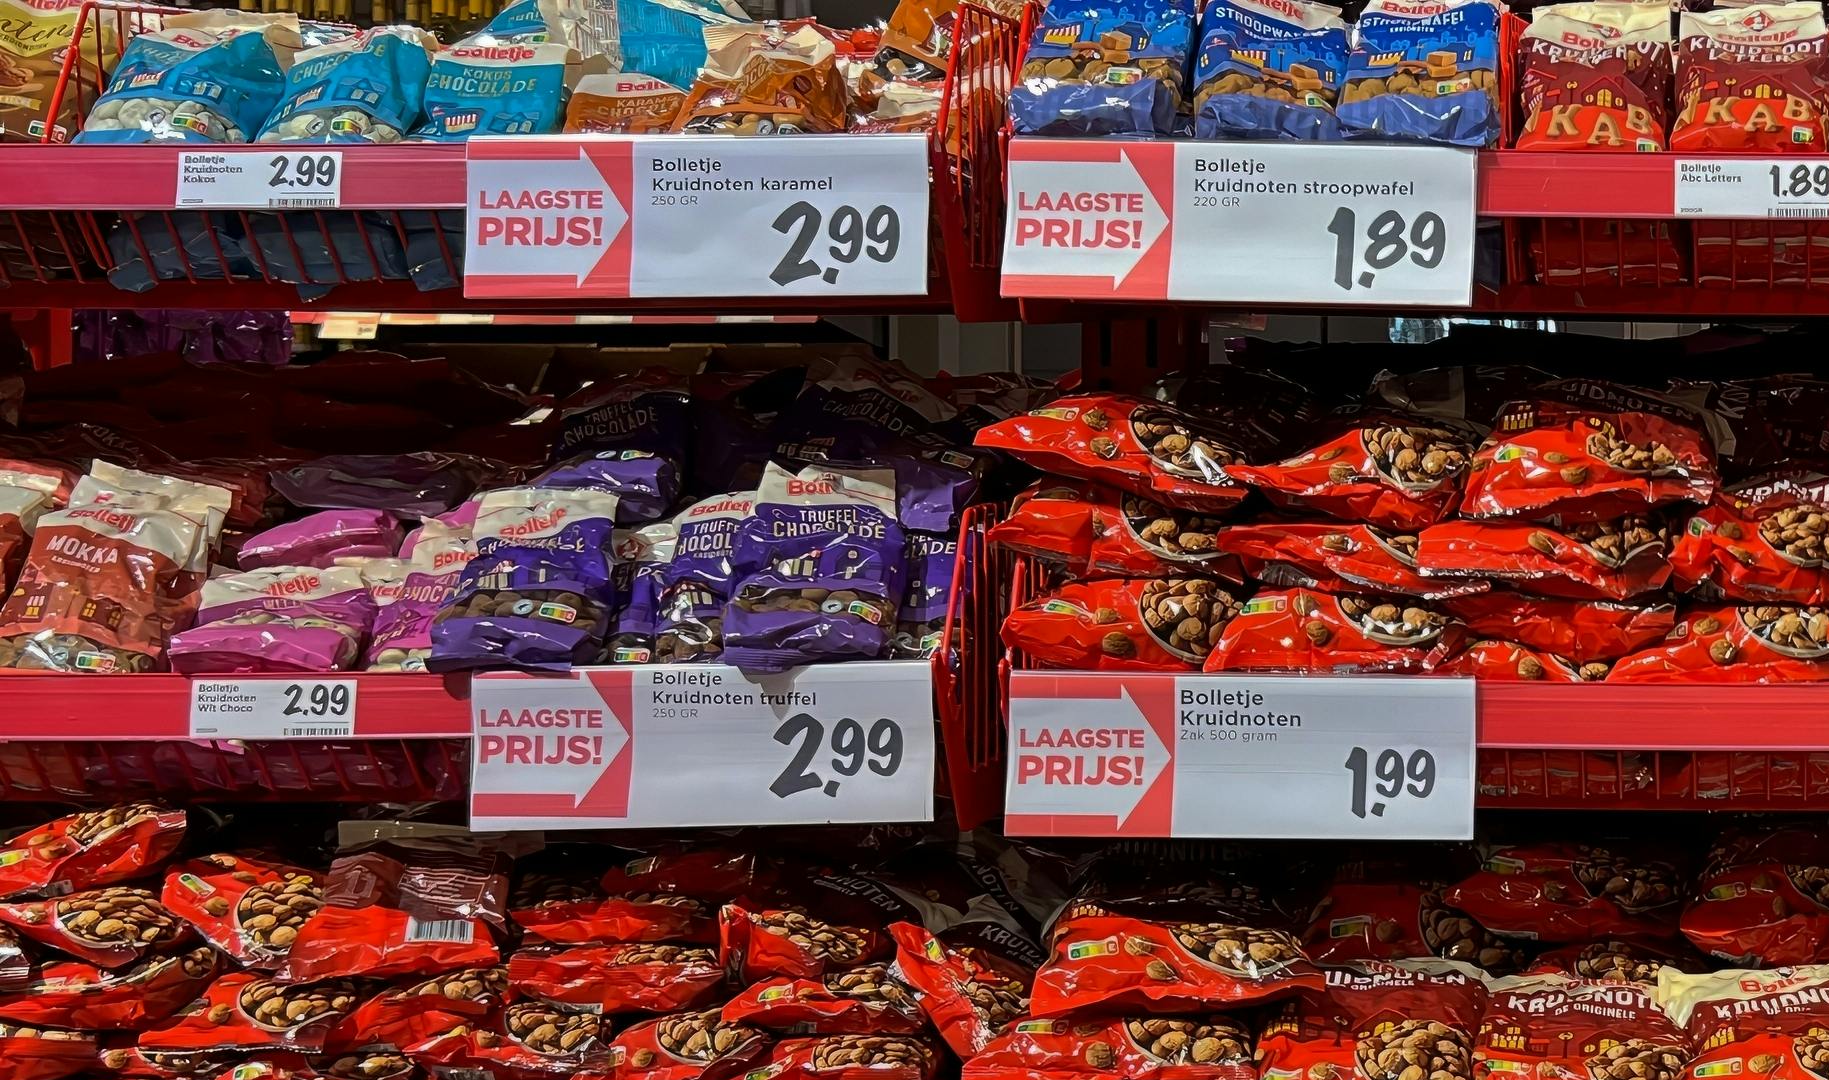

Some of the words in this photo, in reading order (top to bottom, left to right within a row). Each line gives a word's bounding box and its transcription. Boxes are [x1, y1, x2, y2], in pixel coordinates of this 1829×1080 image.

[463, 67, 512, 79] KOKOS
[184, 155, 226, 164] Bolletje
[652, 158, 722, 174] Bolletje
[1194, 158, 1266, 175] Bolletje
[184, 165, 243, 174] Kruidnoten
[268, 155, 336, 187] 2.99
[1680, 164, 1721, 174] Bolletje
[652, 176, 754, 192] Kruidnoten
[760, 176, 833, 192] karamel
[1680, 174, 1701, 183] Abc
[1705, 174, 1742, 183] Letters
[1194, 178, 1297, 195] Kruidnoten
[1303, 181, 1415, 198] stroopwafel
[478, 190, 604, 210] LAAGSTE
[652, 195, 677, 206] 250
[680, 195, 698, 206] GR
[1018, 191, 1144, 213] LAAGSTE
[1194, 196, 1218, 207] 220
[1221, 196, 1241, 207] GR
[476, 216, 604, 247] PRIJS!
[1015, 218, 1143, 250] PRIJS!
[47, 535, 119, 565] MOKKA
[652, 671, 722, 688] Bolletje
[198, 684, 240, 693] Bolletje
[198, 694, 257, 702] Kruidnoten
[282, 684, 350, 716] 2.99
[652, 689, 753, 705] Kruidnoten
[760, 691, 817, 706] truffel
[1180, 689, 1264, 708] Bolletje
[198, 704, 217, 712] Wit
[219, 703, 253, 712] Choco
[652, 708, 677, 718] 250
[680, 708, 698, 718] GR
[480, 708, 603, 729] LAAGSTE
[1180, 710, 1302, 728] Kruidnoten
[1019, 728, 1145, 749] LAAGSTE
[1180, 729, 1204, 741] Zak
[1208, 729, 1237, 741] 500
[1242, 731, 1278, 744] gram
[478, 736, 603, 766] PRIJS!
[1017, 754, 1144, 786] PRIJS!
[1573, 1003, 1637, 1020] ORIGINELE
